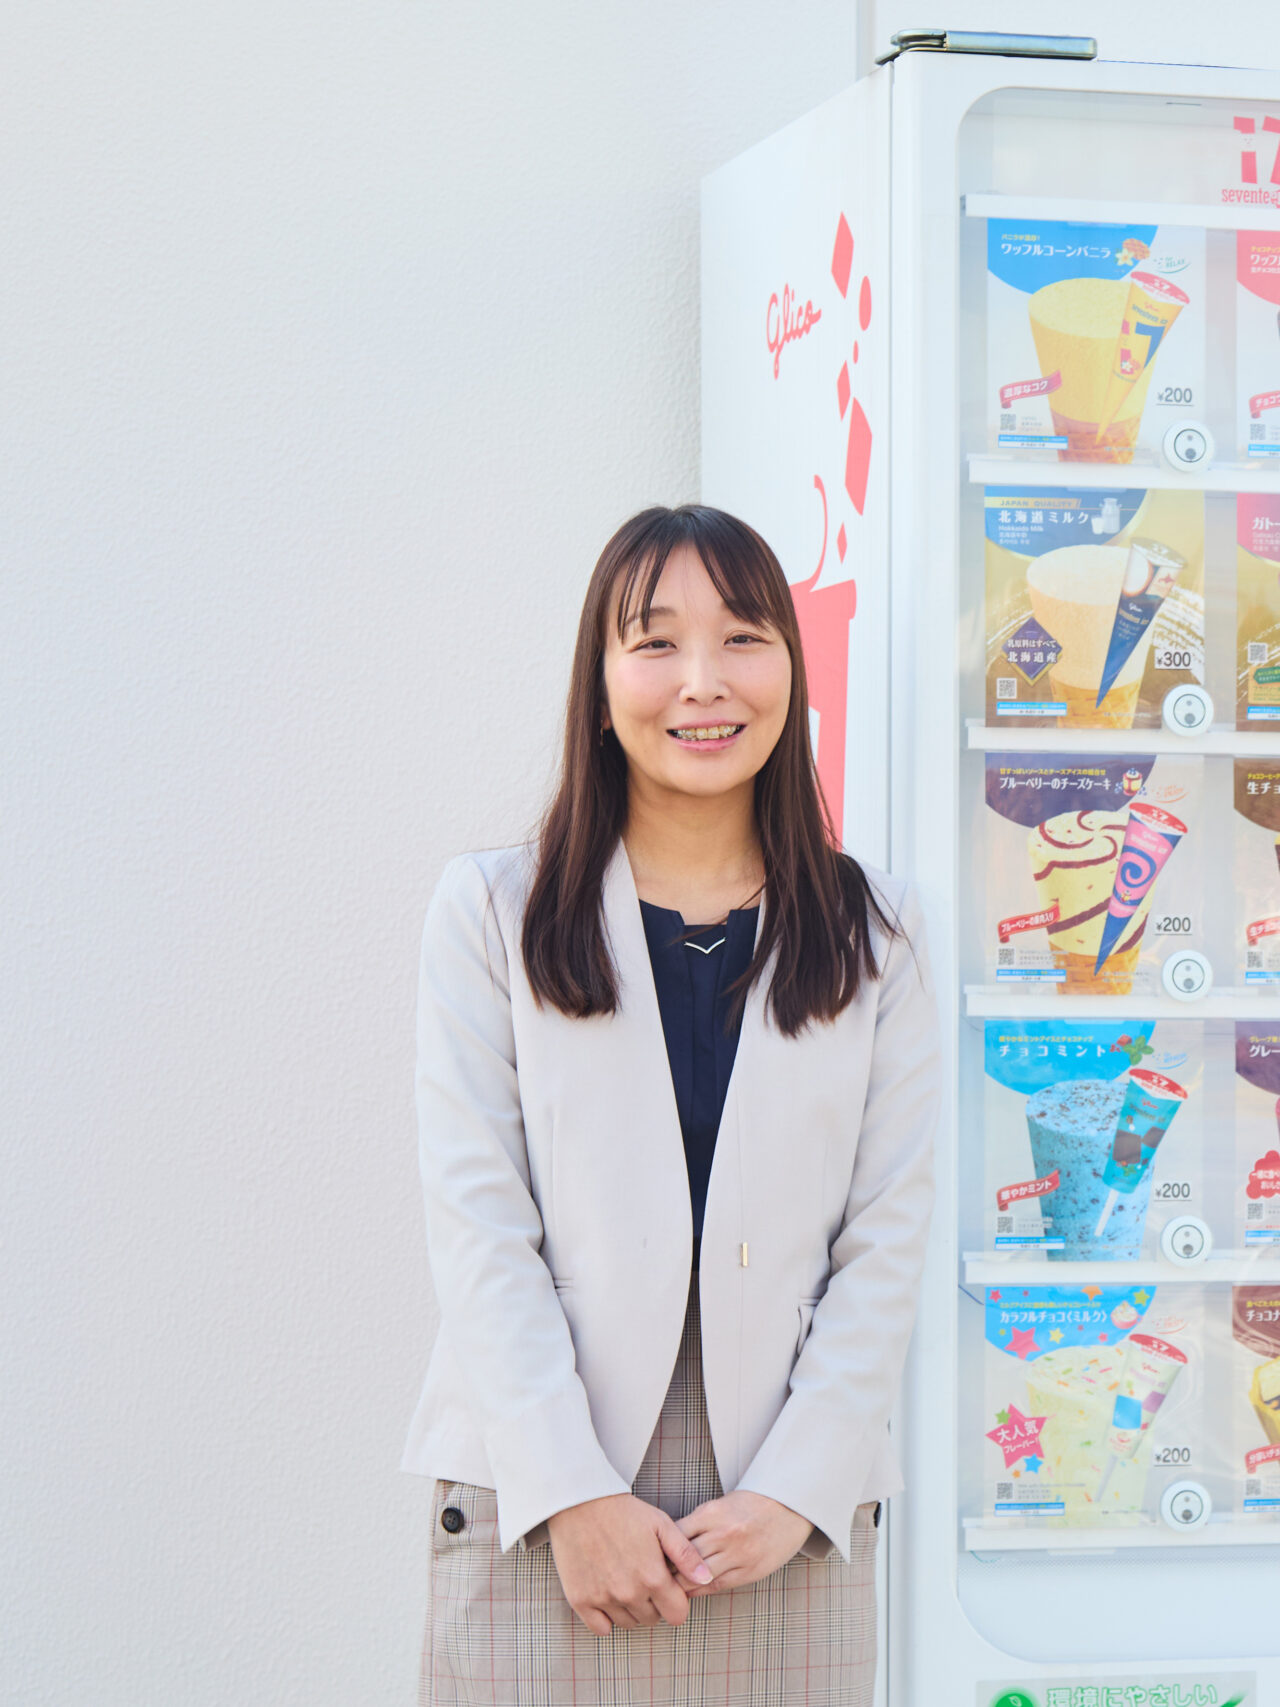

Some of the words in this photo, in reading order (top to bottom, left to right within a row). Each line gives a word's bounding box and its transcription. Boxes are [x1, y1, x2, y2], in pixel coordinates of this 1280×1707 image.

[1001, 243, 1111, 258] ワッフルコーンバニラ
[1004, 380, 1048, 398] 濃厚なコク
[1157, 387, 1192, 403] ¥200
[998, 510, 1089, 525] 北海道ミルク
[1008, 651, 1057, 664] 北海道産
[1157, 651, 1191, 667] ¥300
[999, 777, 1111, 790] ブルーベリーのチーズケーキ
[1156, 917, 1191, 932] ¥200
[999, 1045, 1106, 1058] チョコミント
[1155, 1183, 1191, 1198] ¥200
[997, 1420, 1039, 1442] 大人気
[1155, 1448, 1191, 1463] ¥200
[1046, 1683, 1218, 1707] 環境にやさしい
